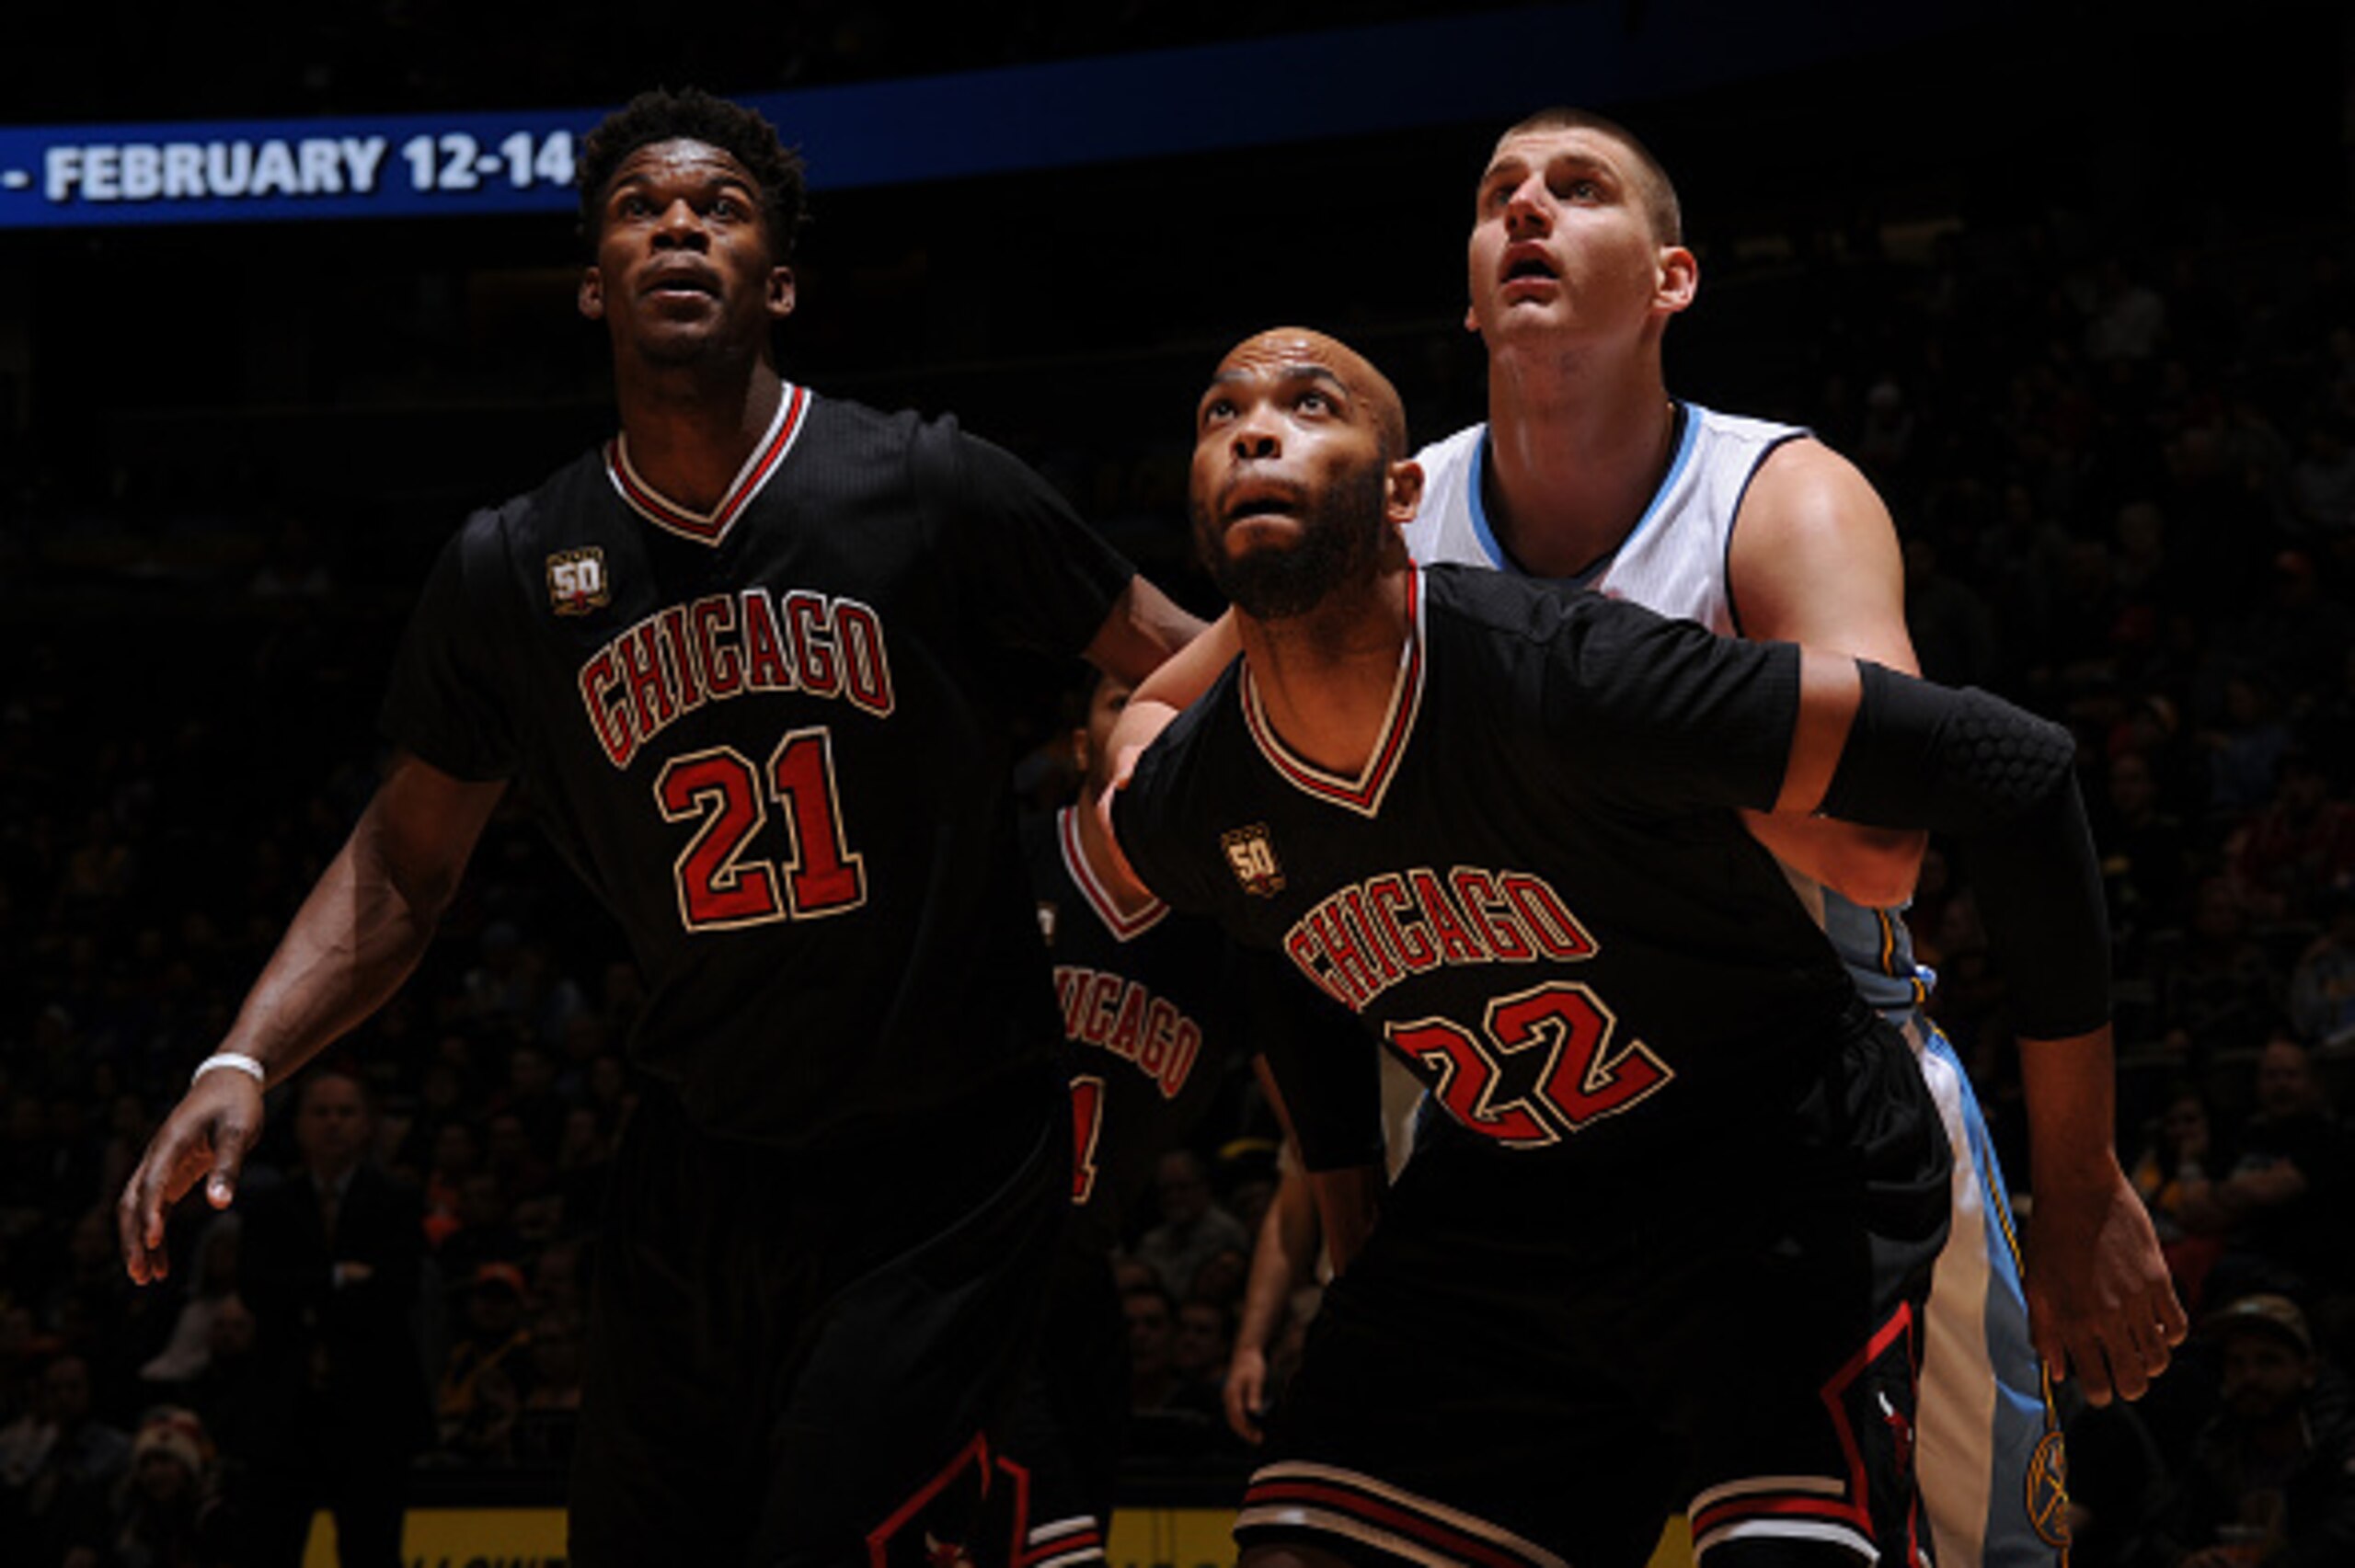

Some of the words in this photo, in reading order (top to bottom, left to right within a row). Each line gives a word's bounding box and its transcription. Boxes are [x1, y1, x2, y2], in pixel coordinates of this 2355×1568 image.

[43, 137, 387, 201] FEBRUARY
[402, 131, 576, 189] 12-14
[551, 559, 601, 600] 50
[577, 586, 897, 772] CHICAGO
[653, 724, 868, 934] 21
[1228, 838, 1275, 882] 50
[1282, 863, 1602, 1013] CHICAGO
[1384, 979, 1676, 1150] 22
